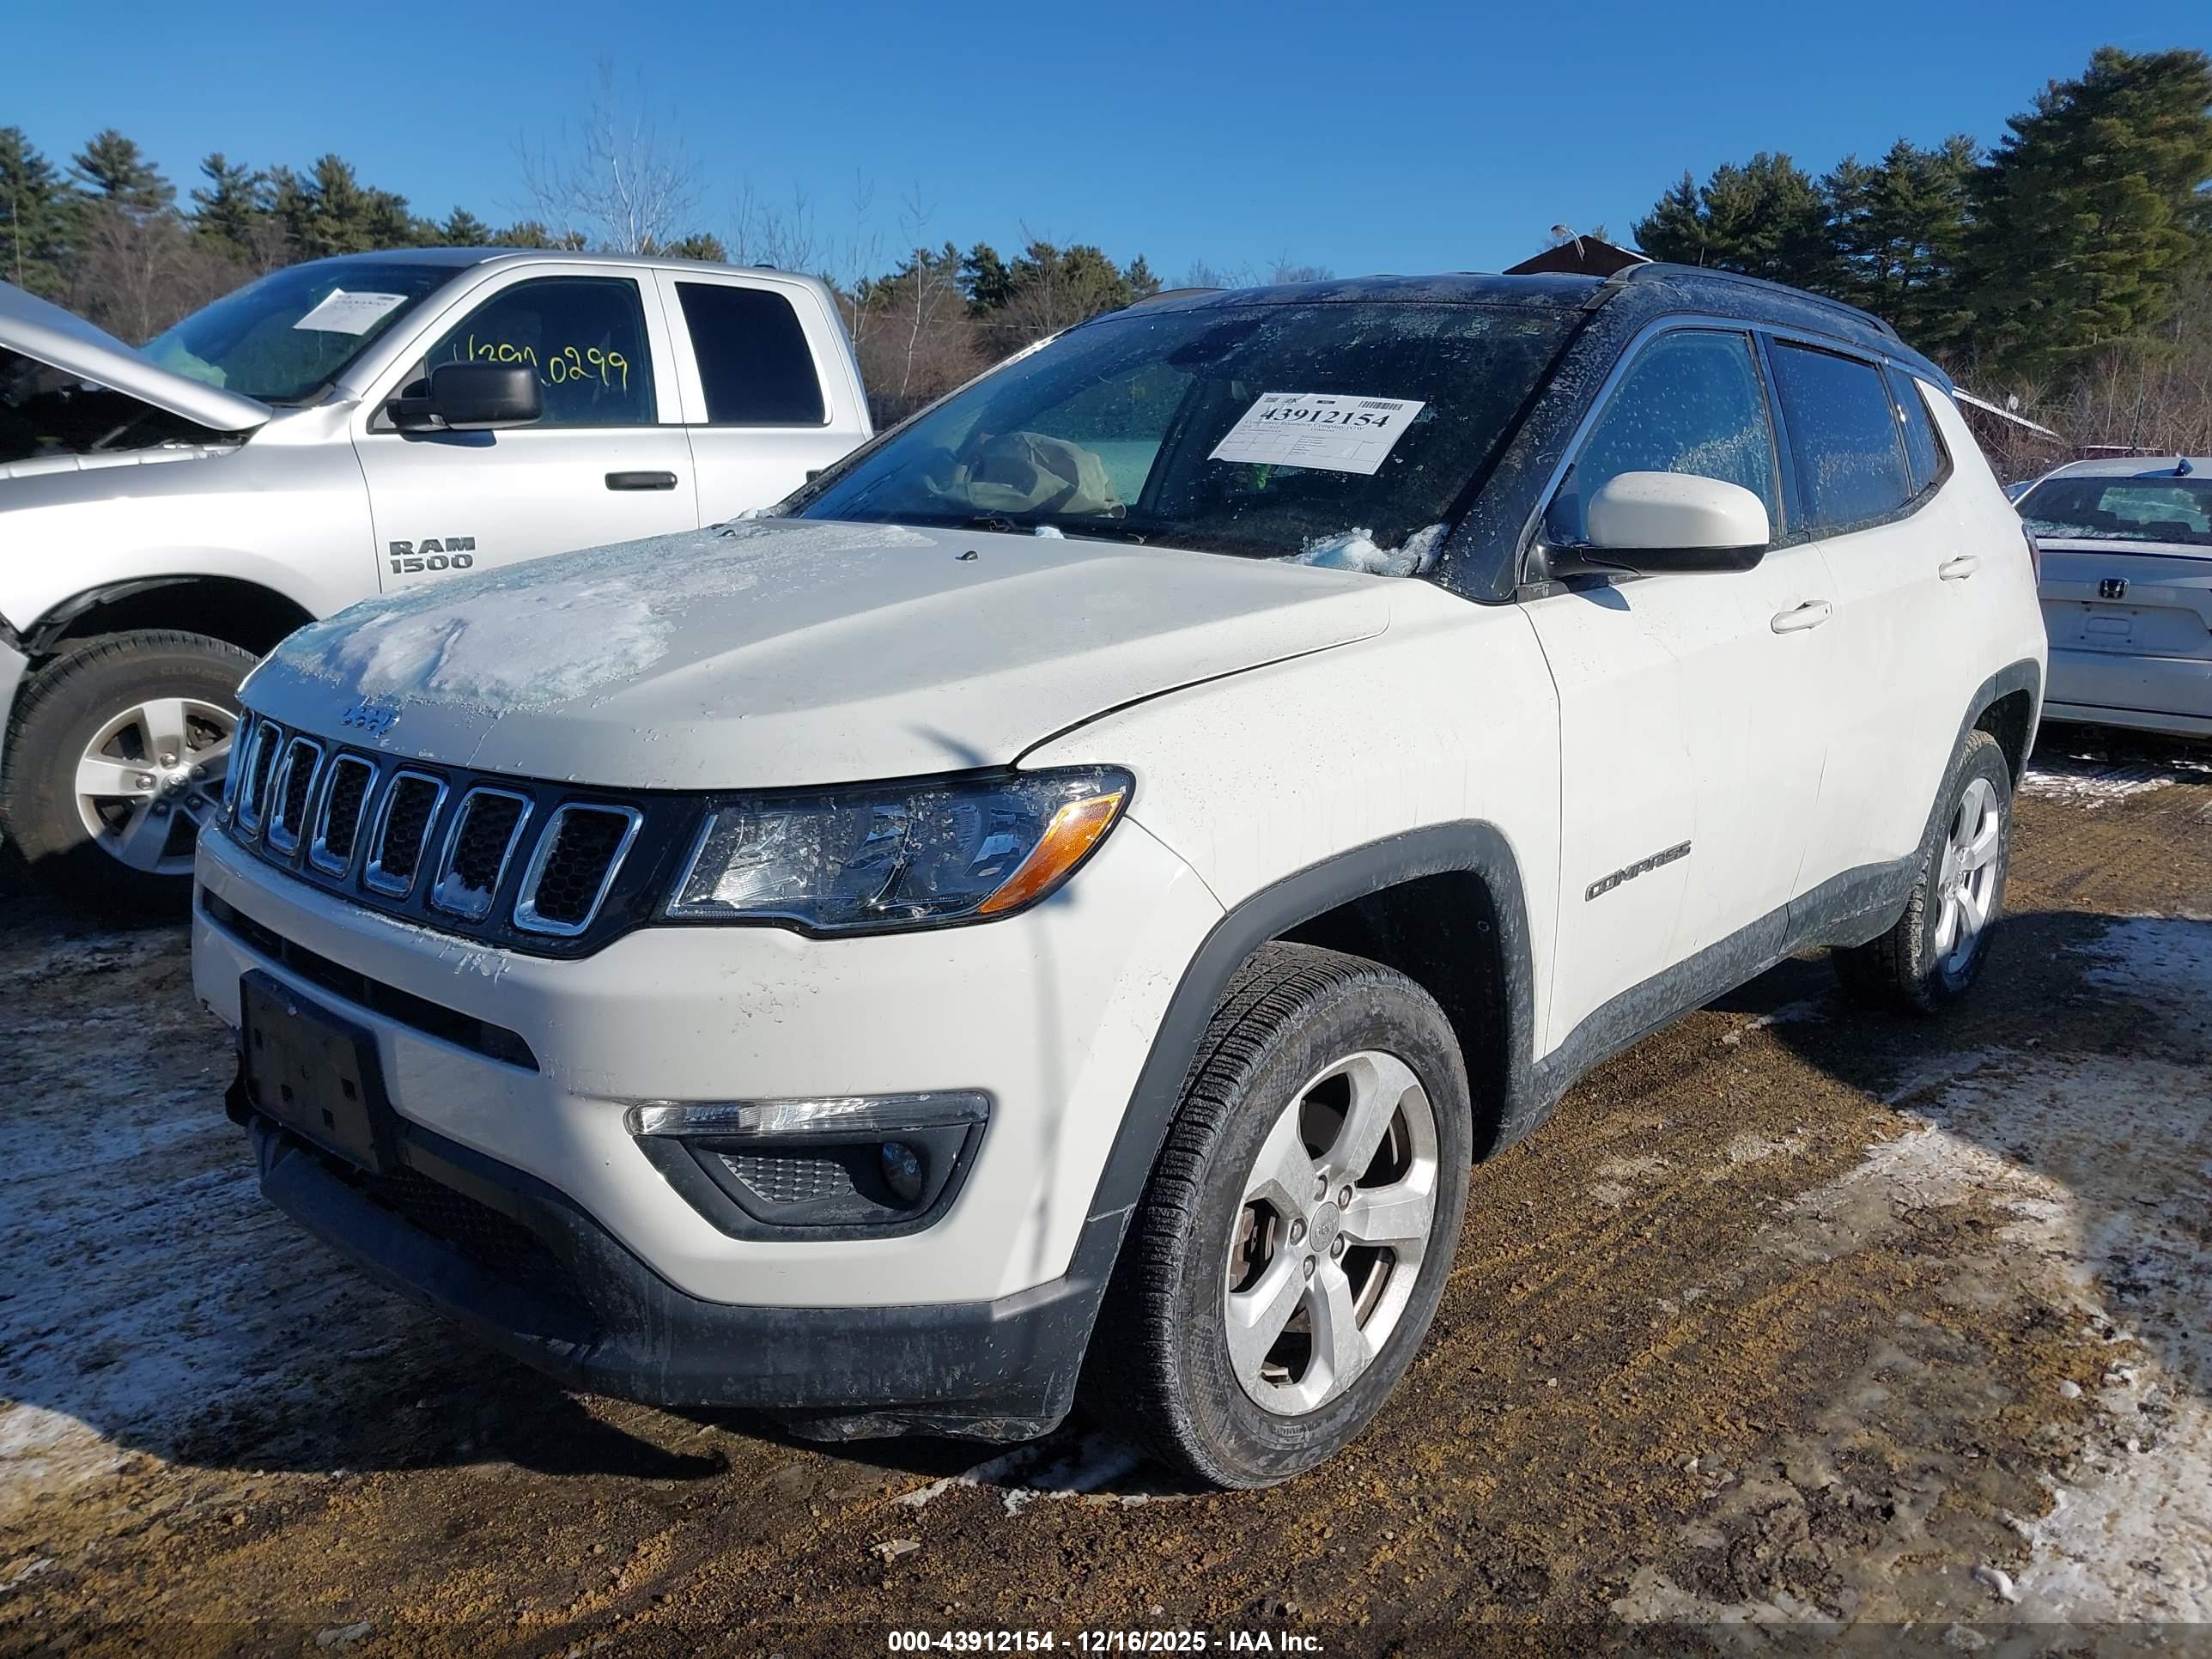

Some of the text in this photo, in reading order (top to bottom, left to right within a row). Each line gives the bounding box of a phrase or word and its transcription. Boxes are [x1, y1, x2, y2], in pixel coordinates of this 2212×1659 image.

[1260, 408, 1391, 428] 43912154
[389, 538, 476, 555] RAM
[391, 555, 473, 574] 1500
[1585, 840, 1692, 902] COMPASS
